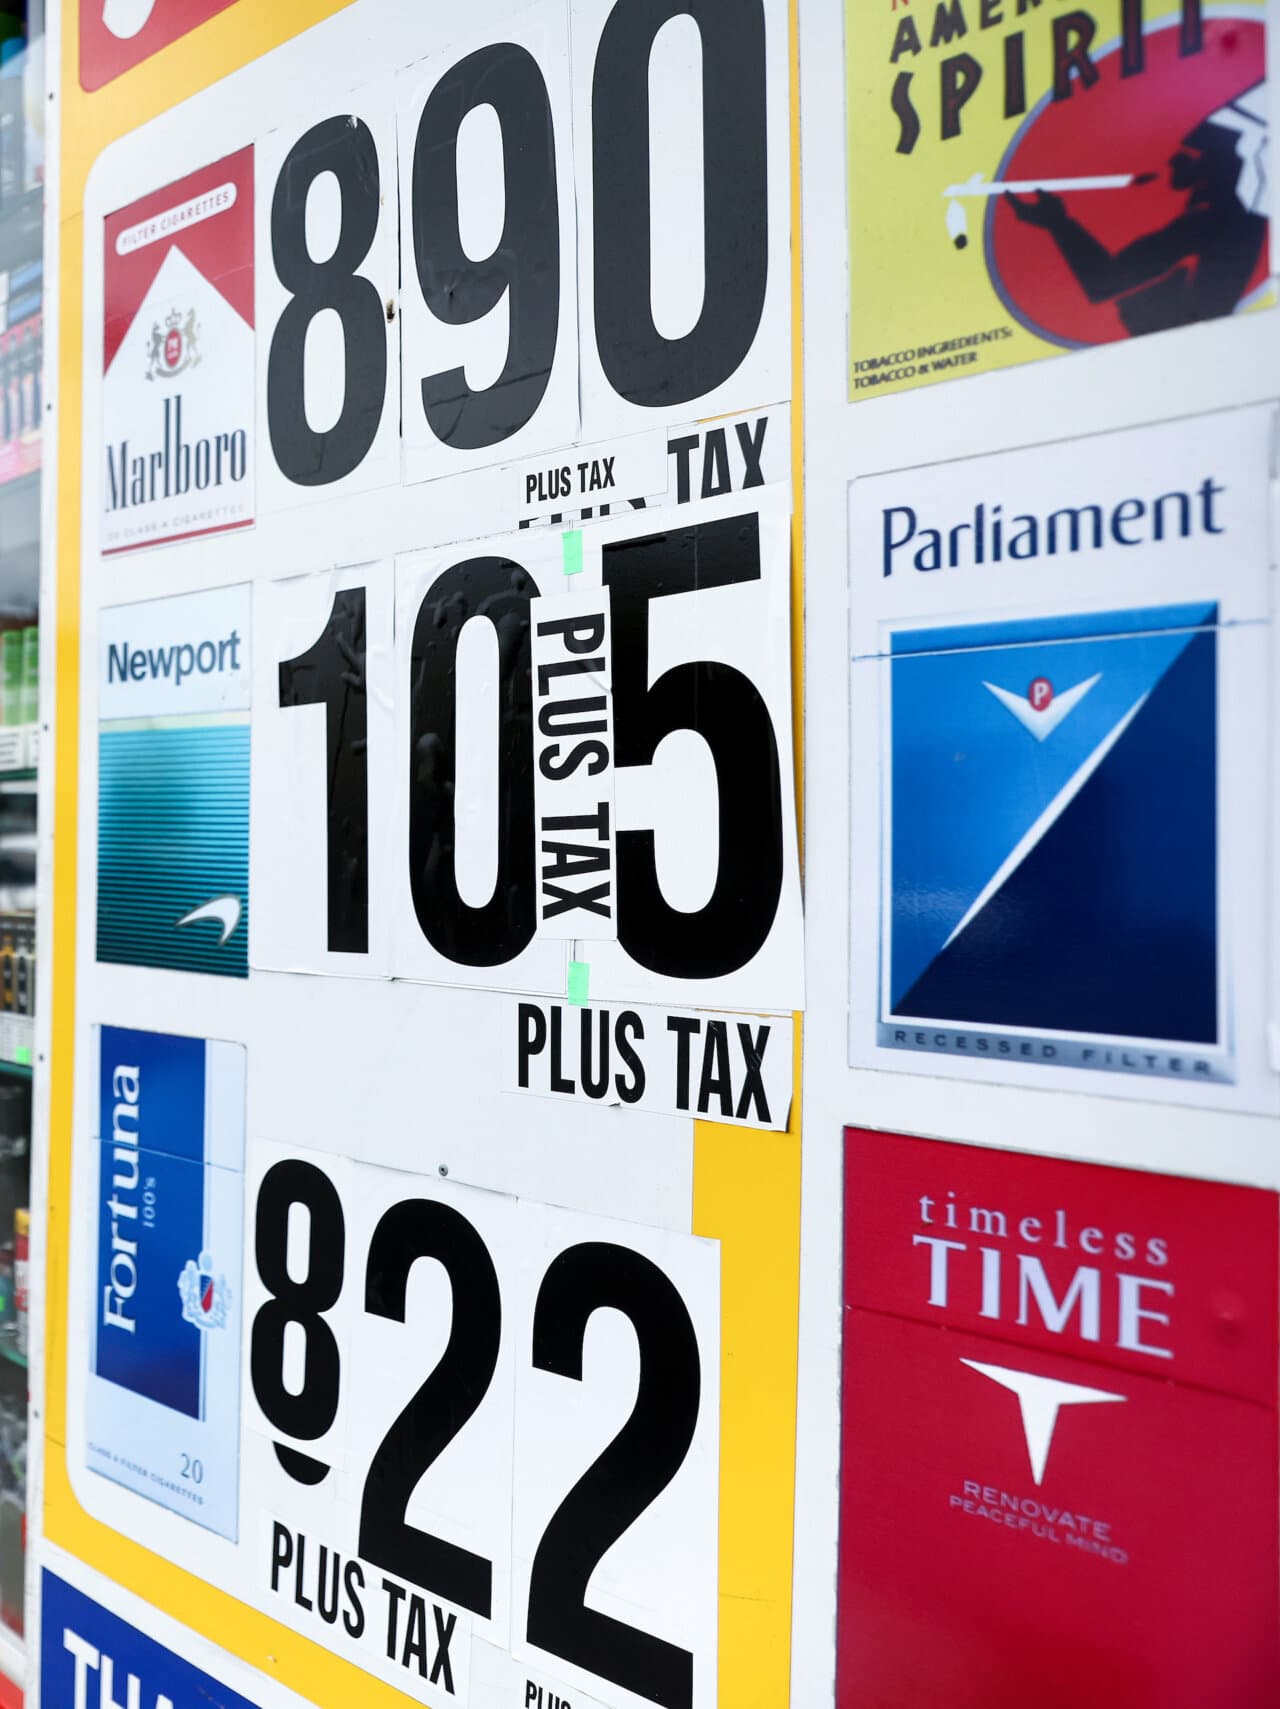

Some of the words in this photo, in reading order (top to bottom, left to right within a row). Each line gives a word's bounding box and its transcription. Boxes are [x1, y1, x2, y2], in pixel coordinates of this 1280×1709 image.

[122, 223, 156, 248] FILTER
[160, 191, 229, 231] CIGARETTES
[267, 0, 768, 487] 890
[854, 349, 916, 374] TOBACCO
[854, 366, 916, 389] TOBACCO
[918, 363, 929, 375] &
[931, 351, 978, 371] WATER
[105, 394, 247, 513] Marlboro
[526, 466, 571, 504] PLUS
[578, 456, 616, 494] TAX
[668, 417, 768, 504] TAX
[882, 477, 1225, 578] Parliament
[108, 629, 241, 687] Newport
[537, 613, 610, 781] PLUS
[1033, 682, 1050, 707] P
[278, 511, 783, 980] 105
[541, 802, 612, 920] TAX
[518, 1003, 646, 1104] PLUS
[667, 1016, 772, 1123] TAX
[894, 1030, 1058, 1058] RECESSED
[1082, 1048, 1213, 1075] FILTER
[104, 1064, 140, 1334] Fortuna
[142, 1176, 157, 1228] 100's
[919, 1191, 1169, 1266] timeless
[912, 1234, 1175, 1359] TIME
[181, 1453, 204, 1485] 20
[250, 1158, 701, 1709] 822
[949, 1494, 1060, 1543] PEACEFUL
[1065, 1532, 1130, 1564] MIND
[963, 1480, 1111, 1542] RENOVATE
[272, 1520, 365, 1639] PLUS
[382, 1577, 457, 1696] TAX
[63, 1627, 174, 1709] TH
